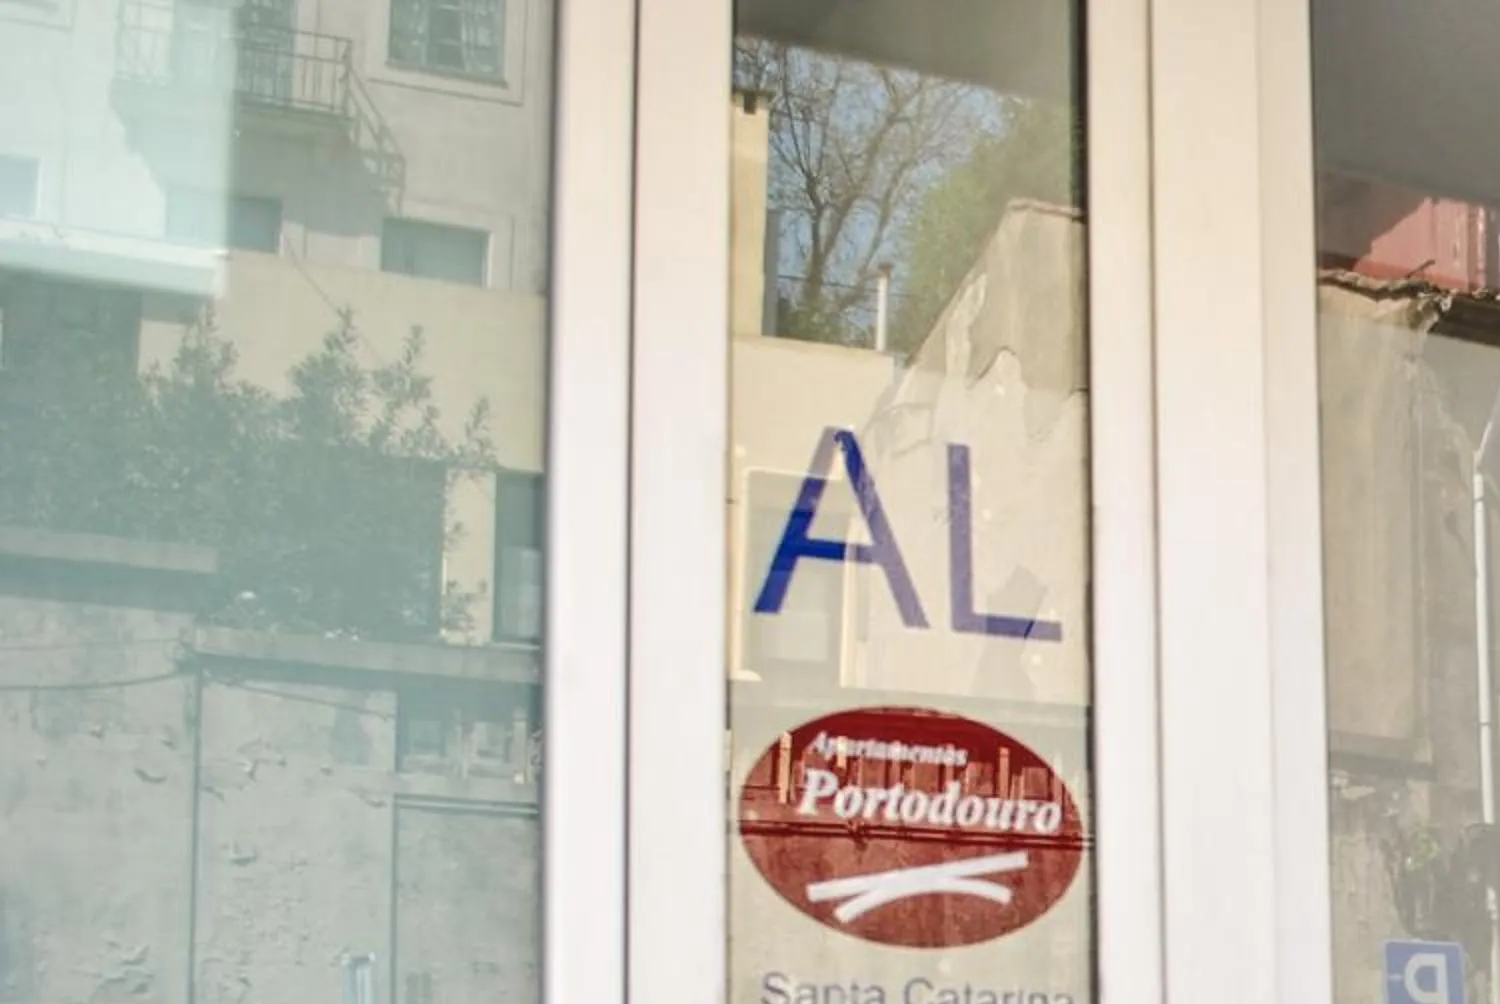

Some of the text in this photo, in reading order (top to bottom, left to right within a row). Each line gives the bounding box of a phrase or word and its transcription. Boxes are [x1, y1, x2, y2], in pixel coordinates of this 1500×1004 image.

[753, 426, 1062, 642] AL
[811, 731, 969, 766] Apartamentos
[797, 768, 1063, 833] Portodouro
